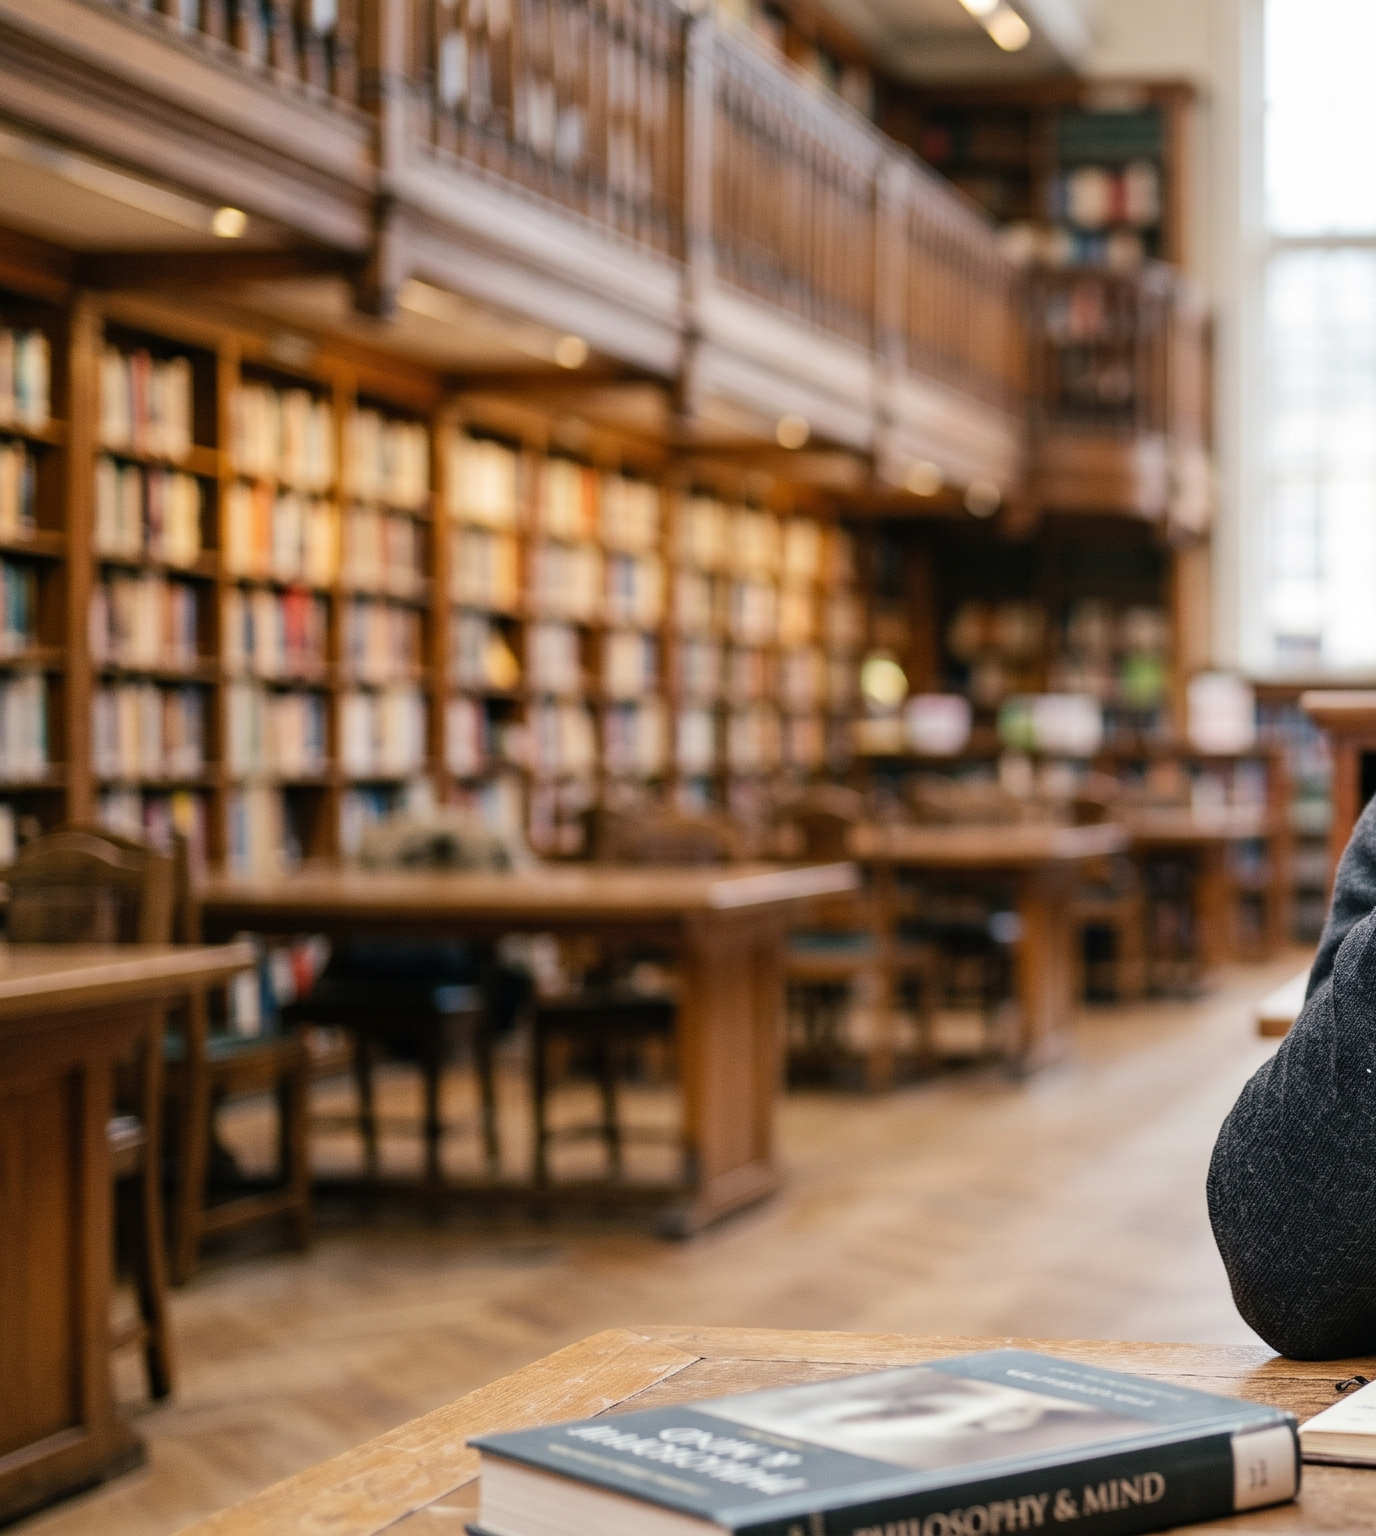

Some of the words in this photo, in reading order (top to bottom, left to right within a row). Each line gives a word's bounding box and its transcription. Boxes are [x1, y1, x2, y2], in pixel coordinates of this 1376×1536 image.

[852, 1492, 1050, 1536] ILOSOPHY
[1052, 1487, 1080, 1523] &
[1081, 1471, 1167, 1517] MIND
